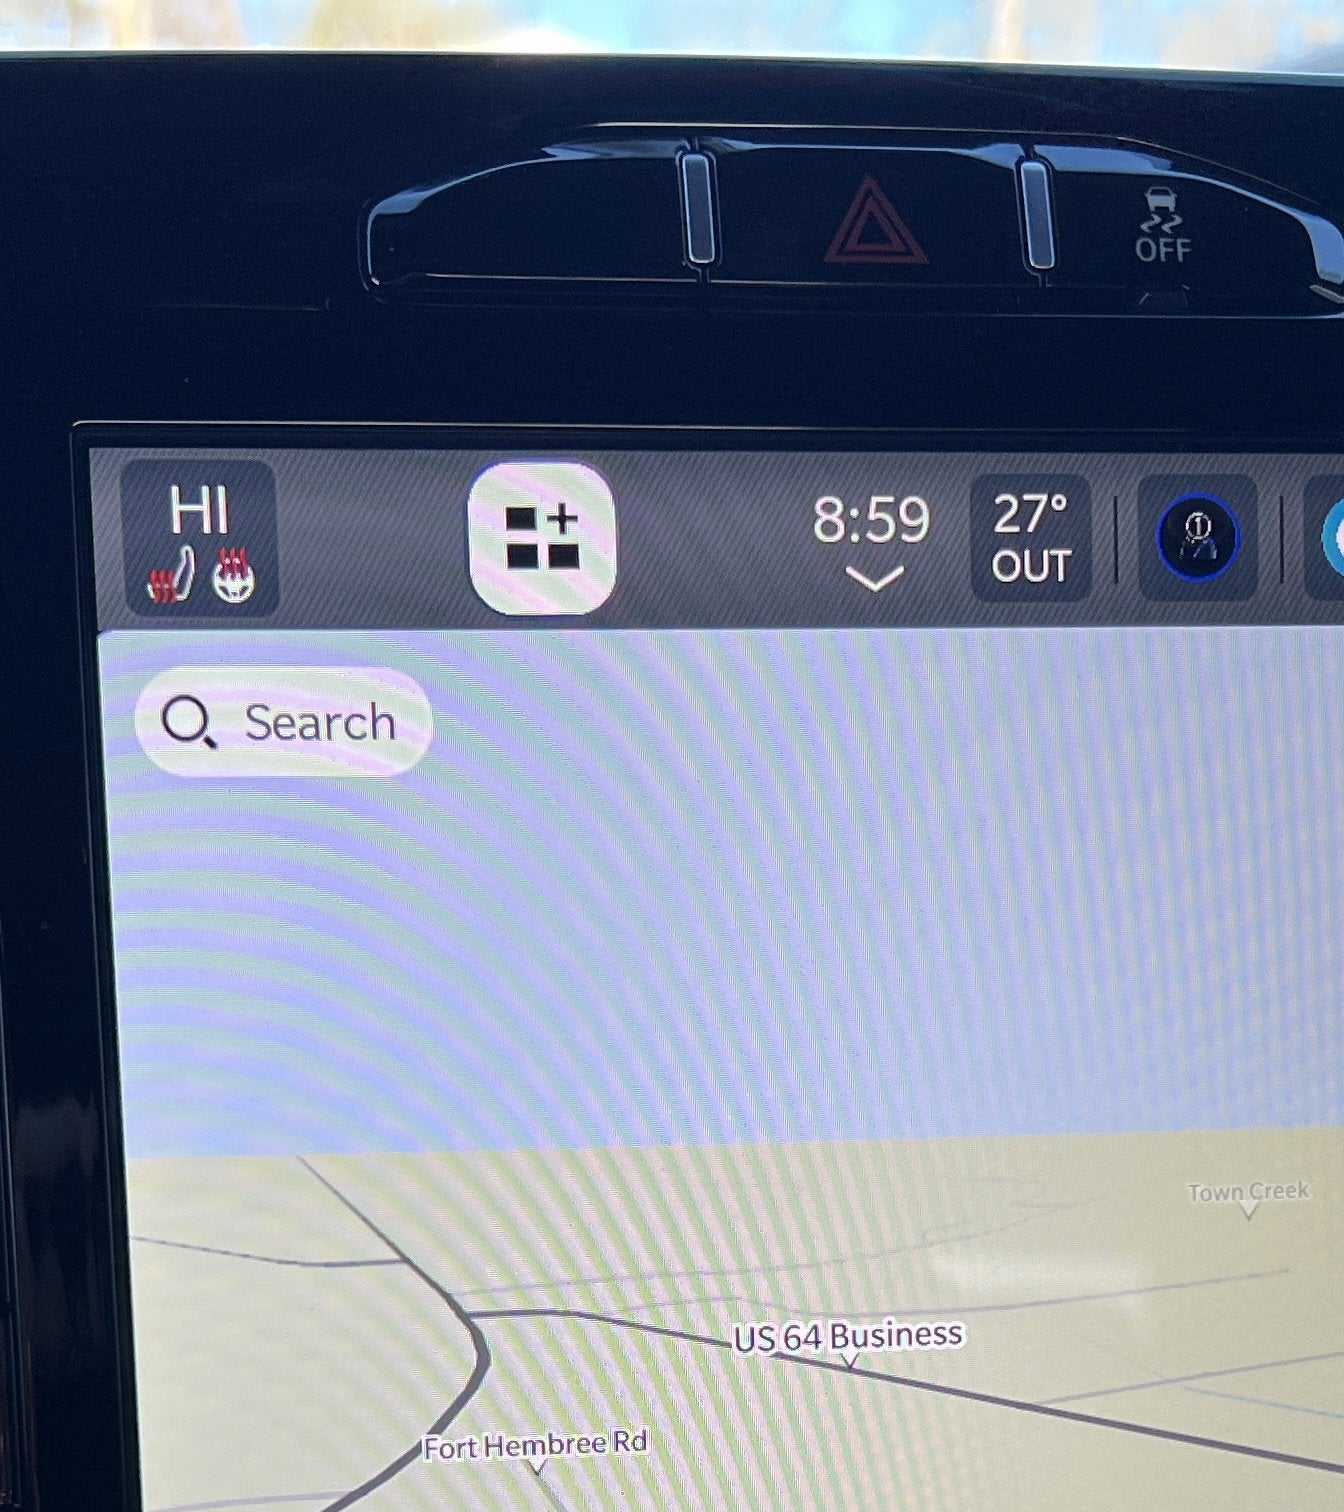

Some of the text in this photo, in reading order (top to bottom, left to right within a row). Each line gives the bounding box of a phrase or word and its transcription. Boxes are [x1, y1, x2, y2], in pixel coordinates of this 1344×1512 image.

[1136, 238, 1190, 261] OFF
[171, 485, 226, 533] HI
[815, 496, 929, 542] 8:59
[995, 494, 1066, 532] 27°
[993, 549, 1072, 581] OUT
[247, 702, 395, 740] Search
[1189, 1180, 1308, 1201] Town Creek
[735, 1321, 962, 1351] US 64 Business
[426, 1430, 646, 1459] Fort Hembree Rd
